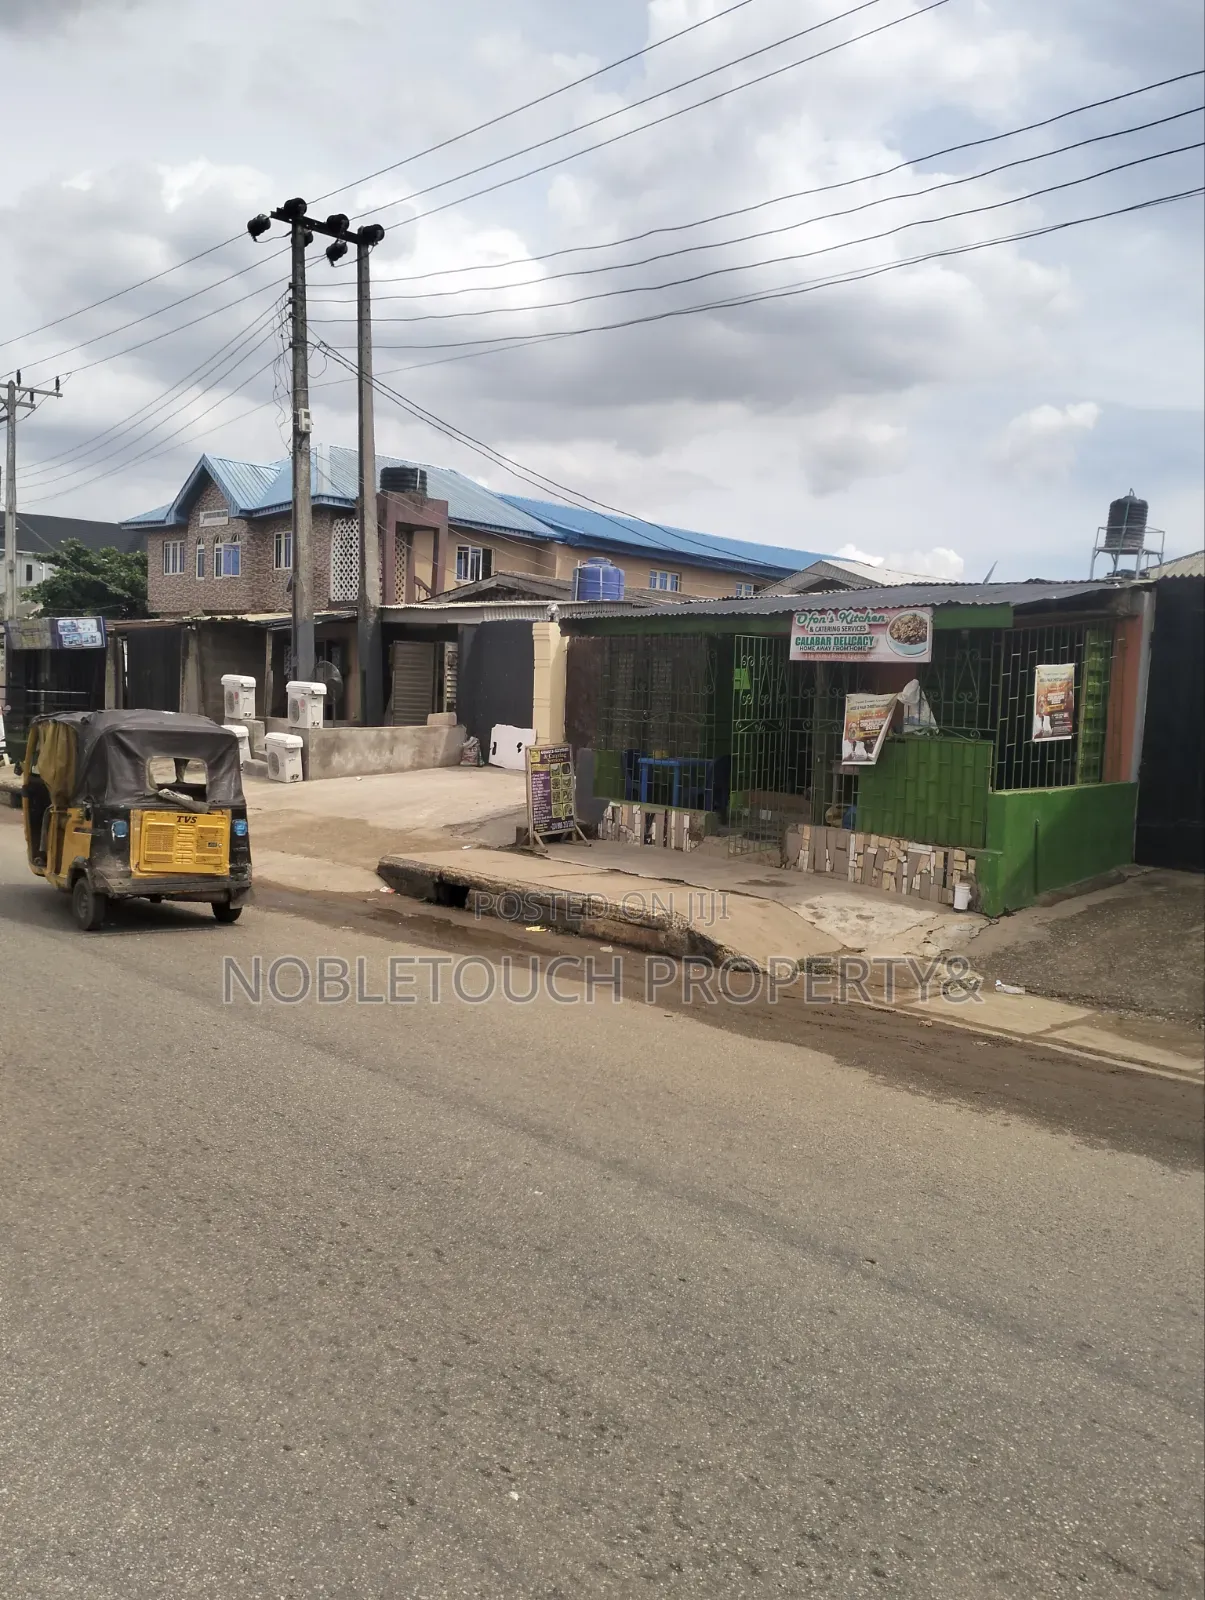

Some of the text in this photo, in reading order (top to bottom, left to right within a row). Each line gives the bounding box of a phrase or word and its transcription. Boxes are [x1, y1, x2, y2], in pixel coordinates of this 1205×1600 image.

[839, 610, 886, 624] Kitchen
[795, 636, 874, 646] CALABAR DELICACY
[176, 815, 198, 824] TVS
